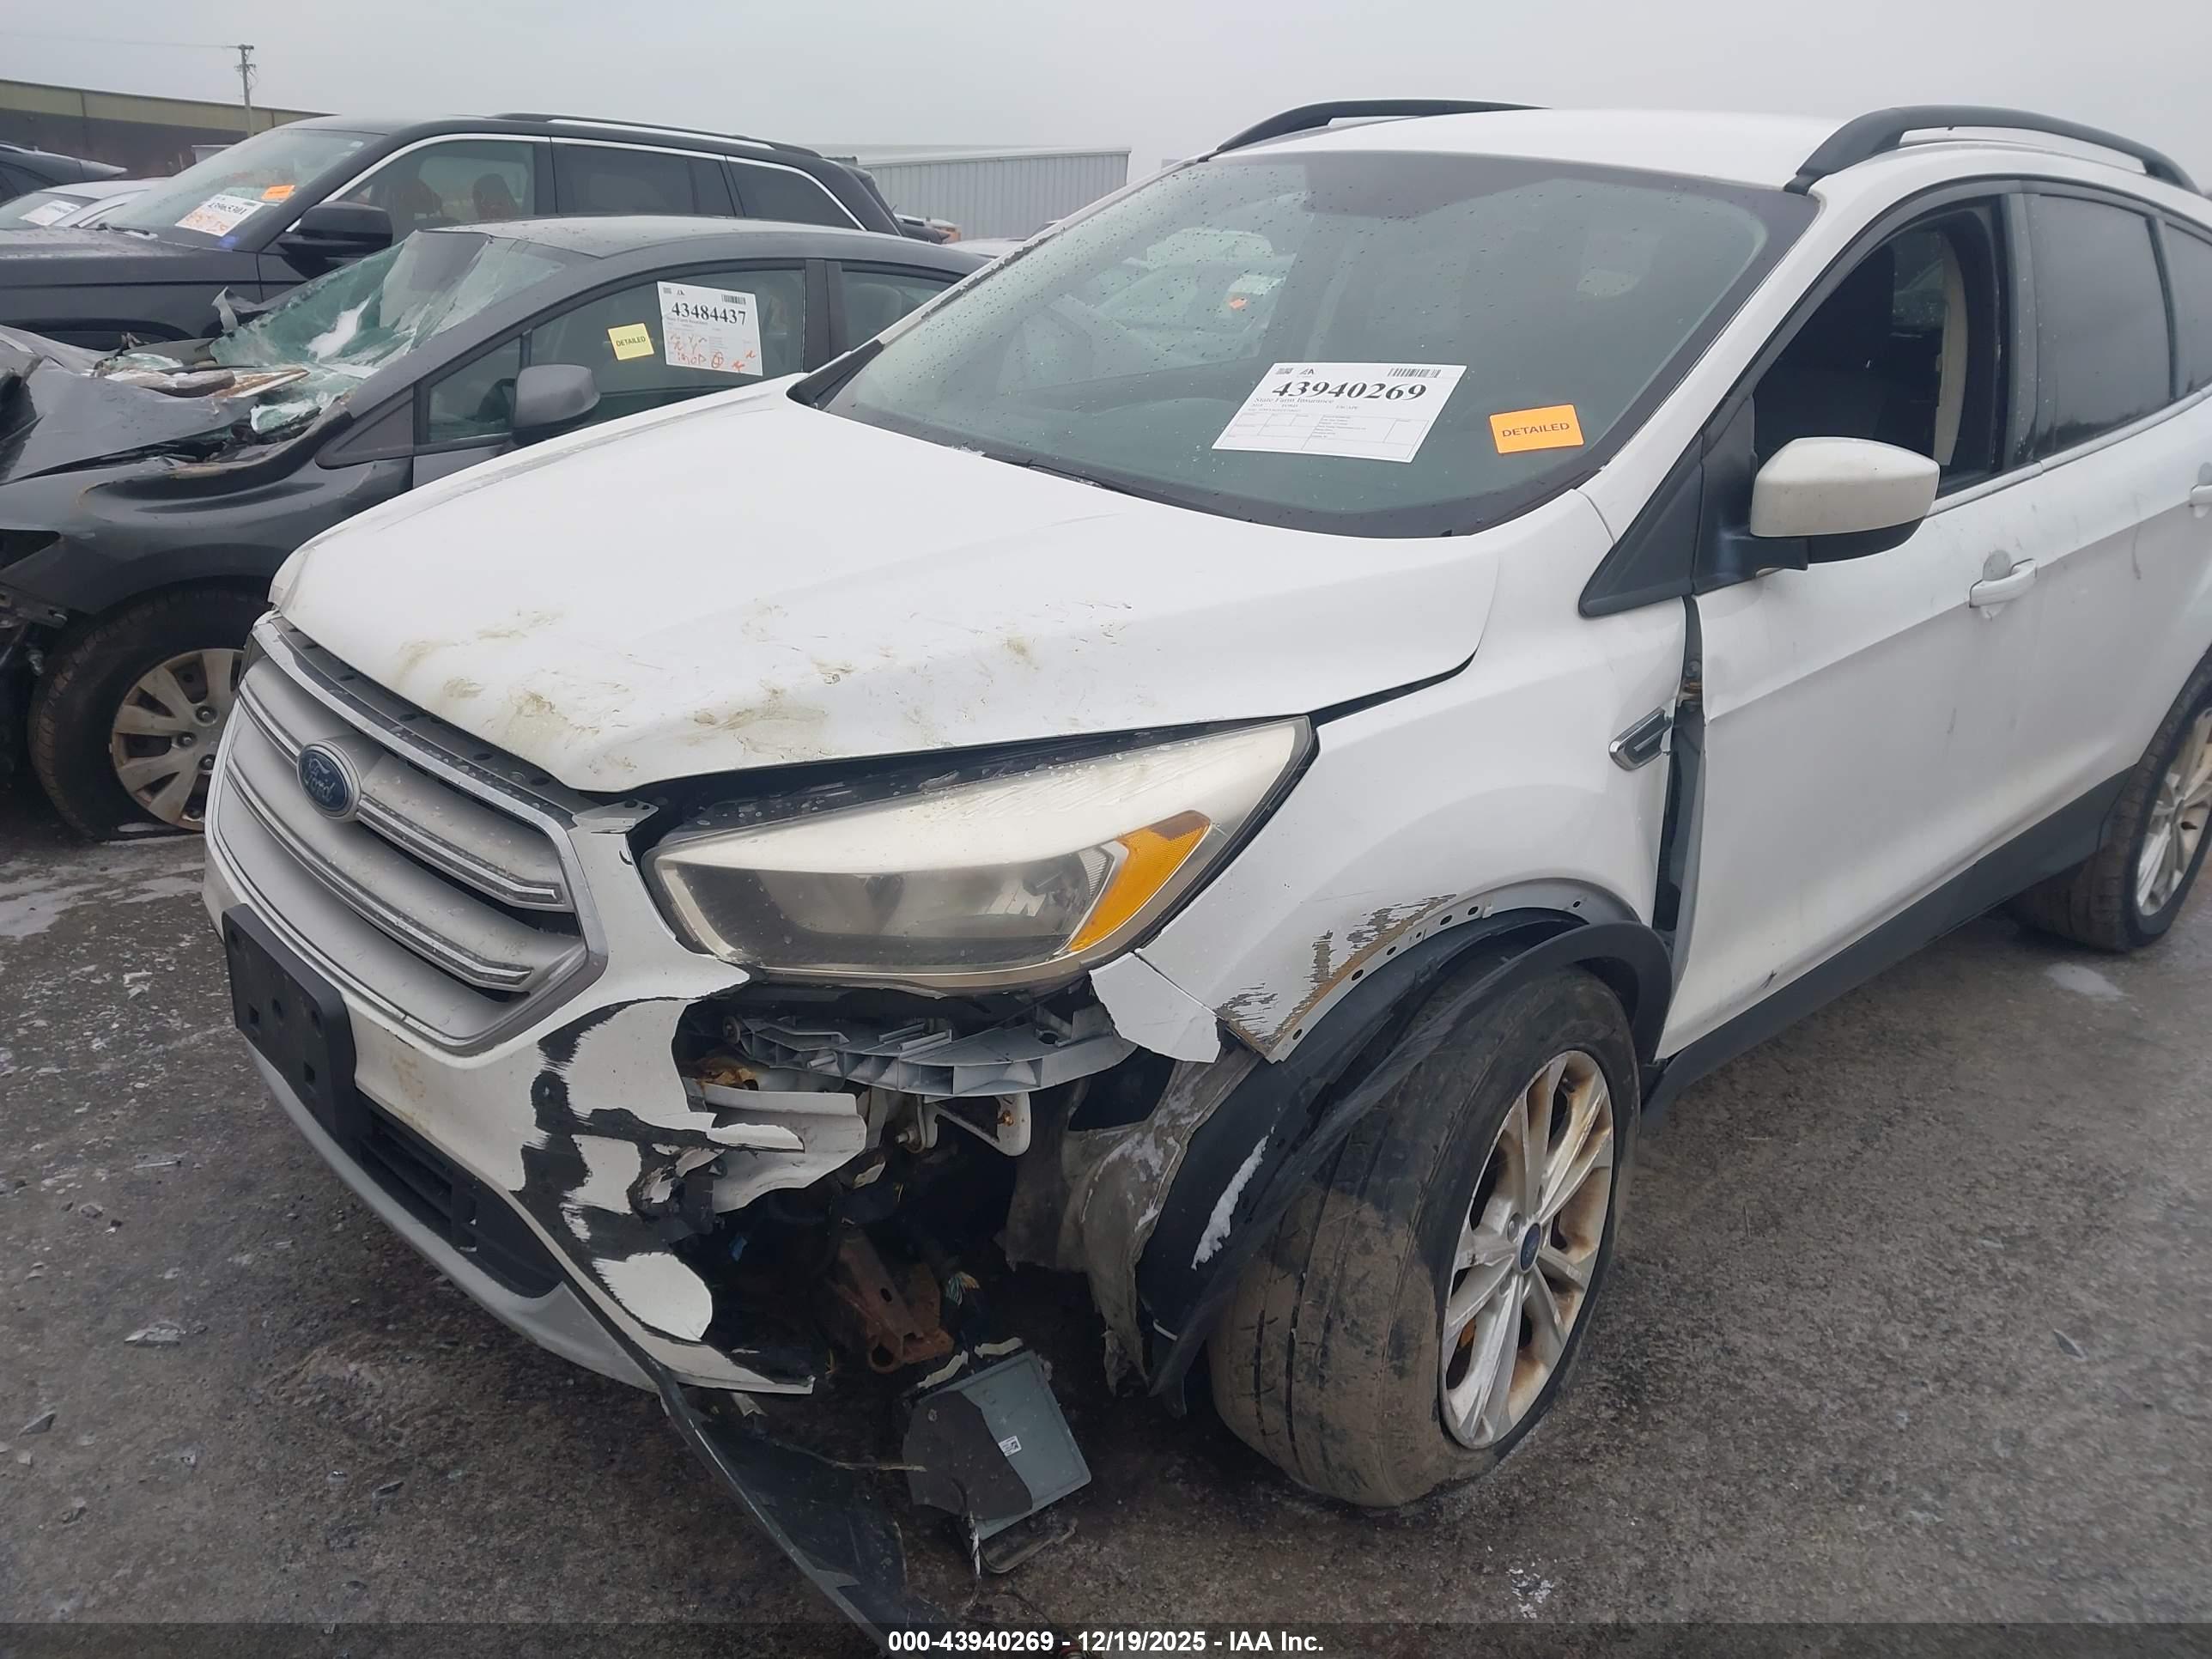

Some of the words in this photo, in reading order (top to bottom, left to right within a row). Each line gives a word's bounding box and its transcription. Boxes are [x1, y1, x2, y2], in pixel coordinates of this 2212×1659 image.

[672, 302, 746, 325] 43484437
[616, 336, 647, 347] DETAILED
[1272, 380, 1427, 401] 43940269
[1501, 422, 1571, 438] DETAILED
